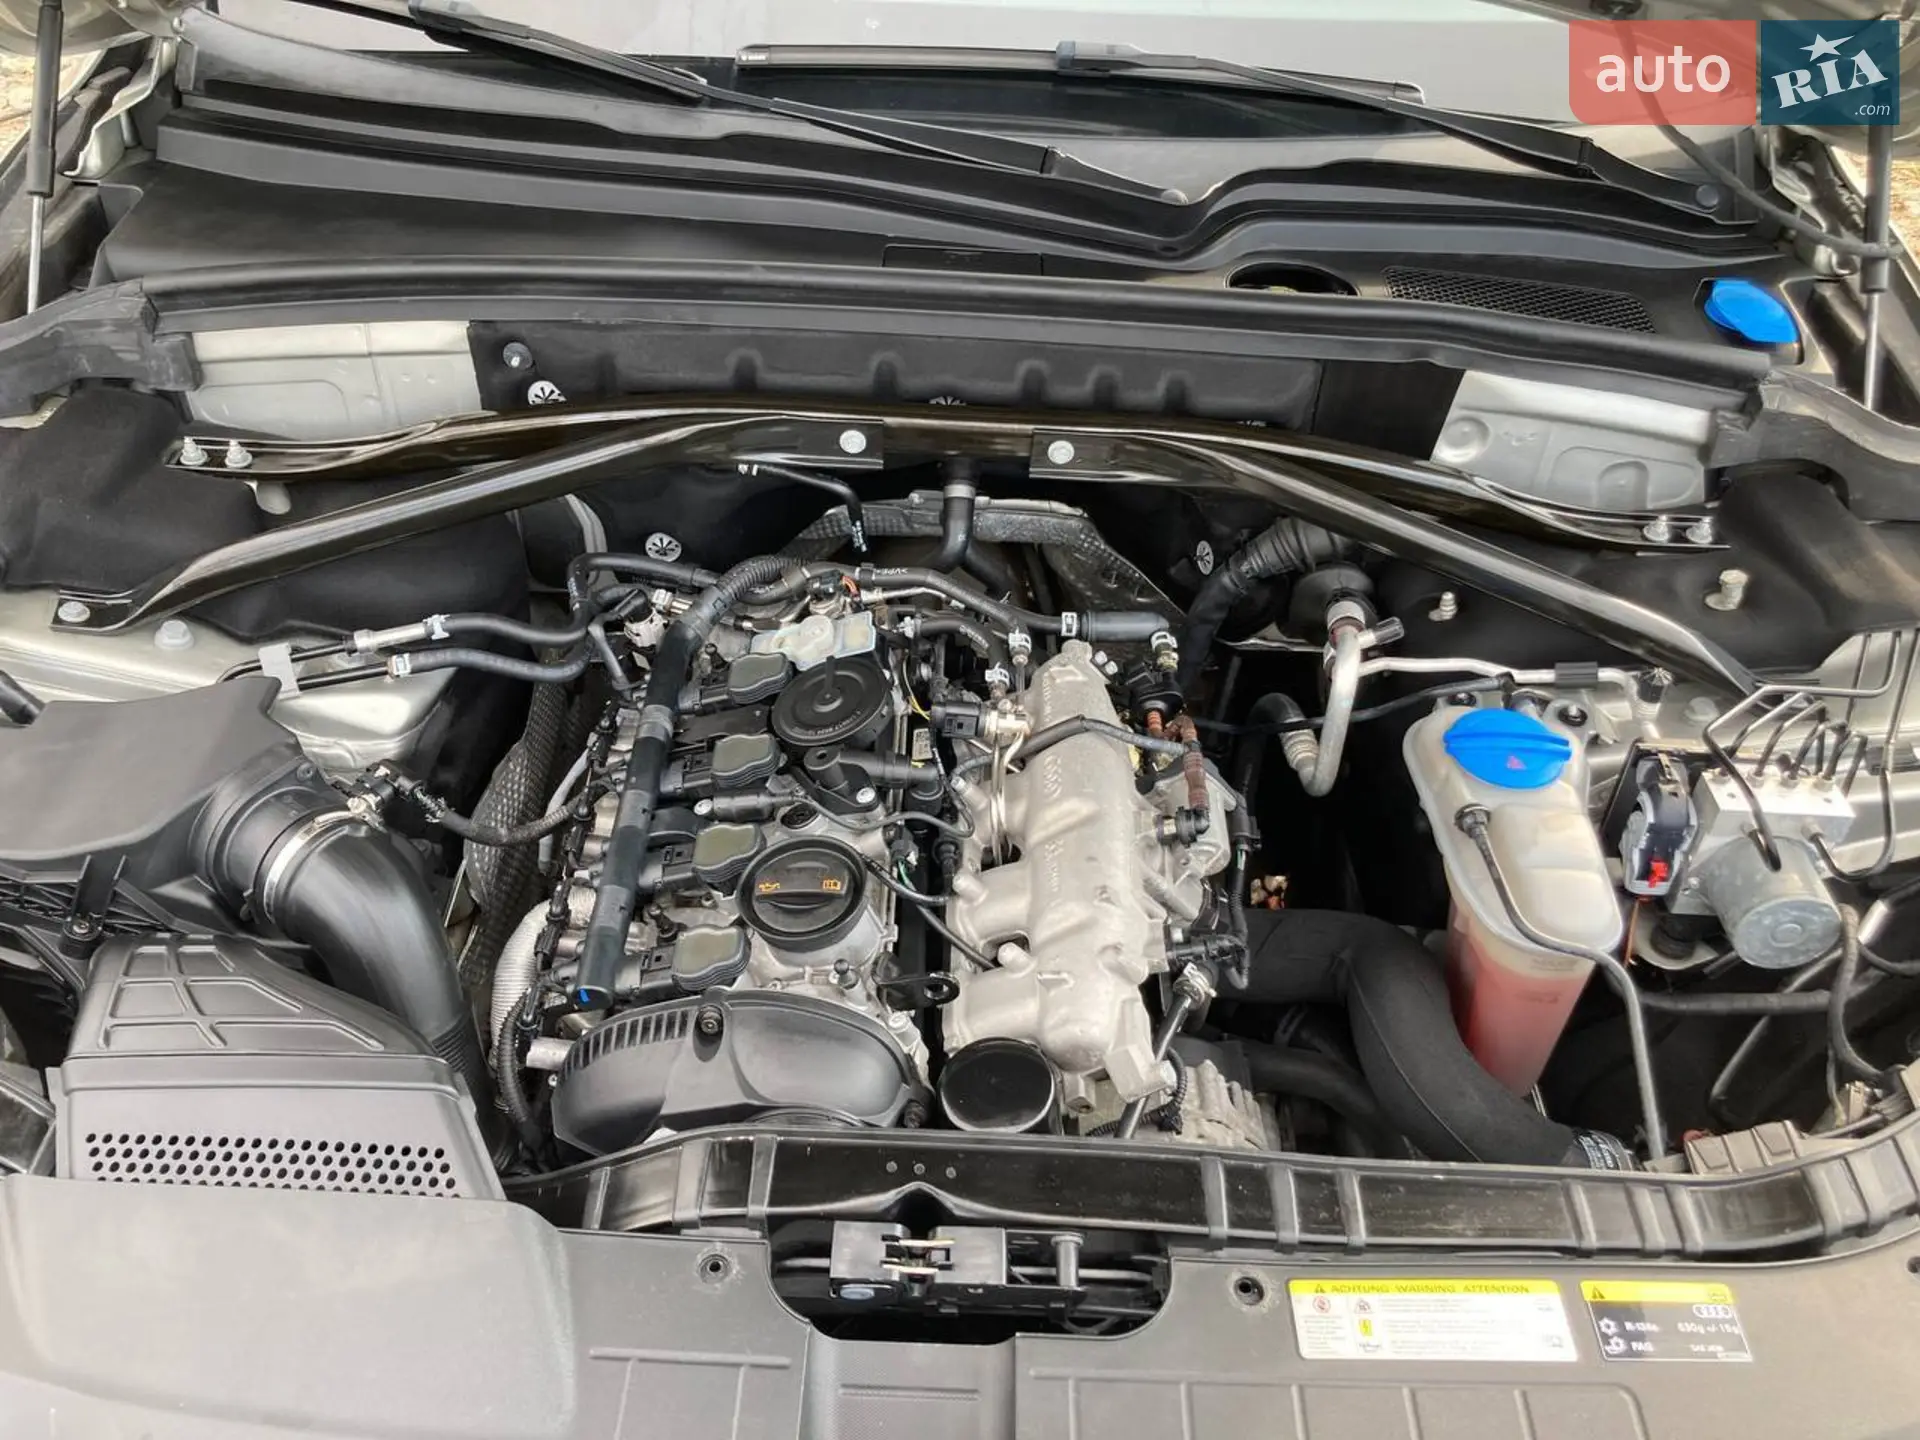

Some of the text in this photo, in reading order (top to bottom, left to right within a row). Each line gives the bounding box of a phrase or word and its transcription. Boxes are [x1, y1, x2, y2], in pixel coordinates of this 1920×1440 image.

[1331, 1284, 1530, 1294] ACHTUNG WARNING ATTENTION
